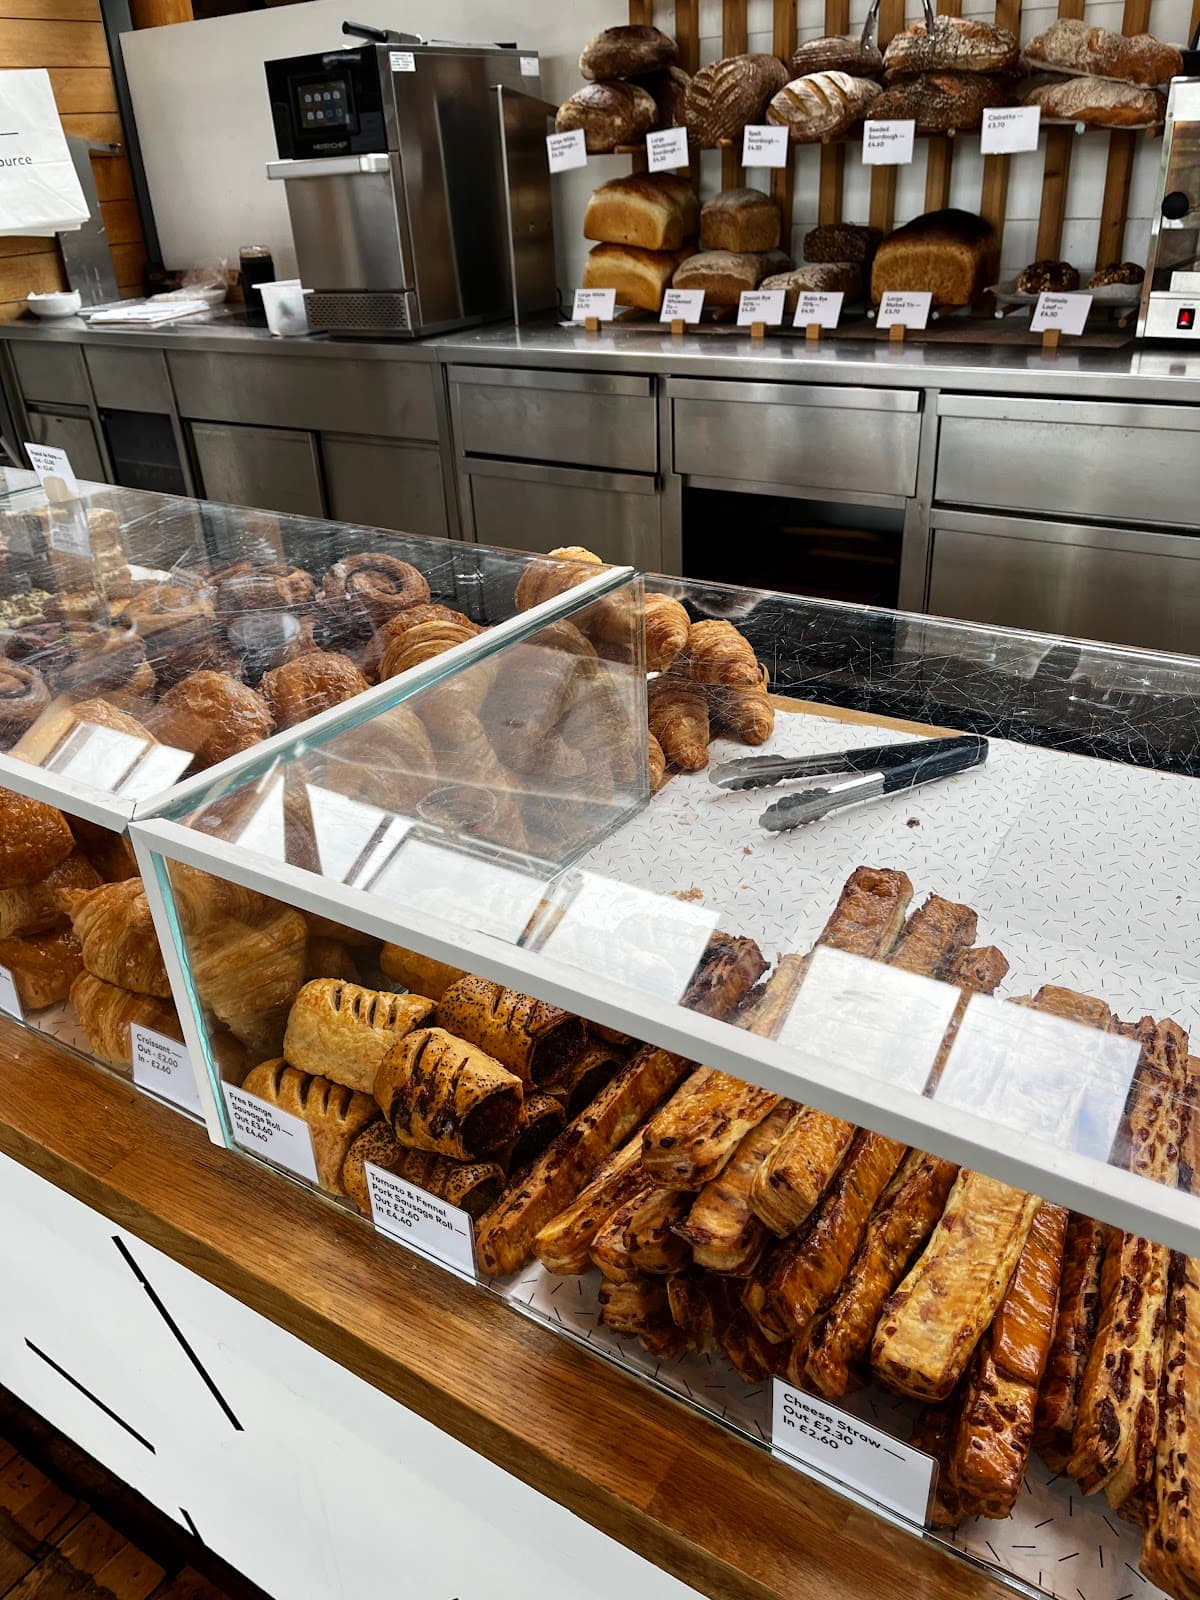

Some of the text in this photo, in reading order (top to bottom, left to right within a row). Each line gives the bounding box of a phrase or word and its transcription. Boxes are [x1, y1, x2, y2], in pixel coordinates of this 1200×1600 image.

[136, 1033, 170, 1054] Croissant
[138, 1044, 151, 1056] Out
[158, 1053, 178, 1067] £2.00
[138, 1054, 145, 1063] In
[229, 1092, 272, 1118] Free Range
[232, 1102, 280, 1131] Sausage Roll
[234, 1112, 273, 1136] Out £3.60
[236, 1122, 267, 1142] In £4.40
[370, 1172, 446, 1217] Tomato & Fennel
[372, 1183, 453, 1231] Pork Sausage Roll
[374, 1193, 420, 1222] Out £3.60
[375, 1203, 412, 1227] In £4.40
[783, 1393, 881, 1449] Cheese Straw
[783, 1405, 853, 1446] Out £2.30
[783, 1415, 839, 1450] In £2.60
